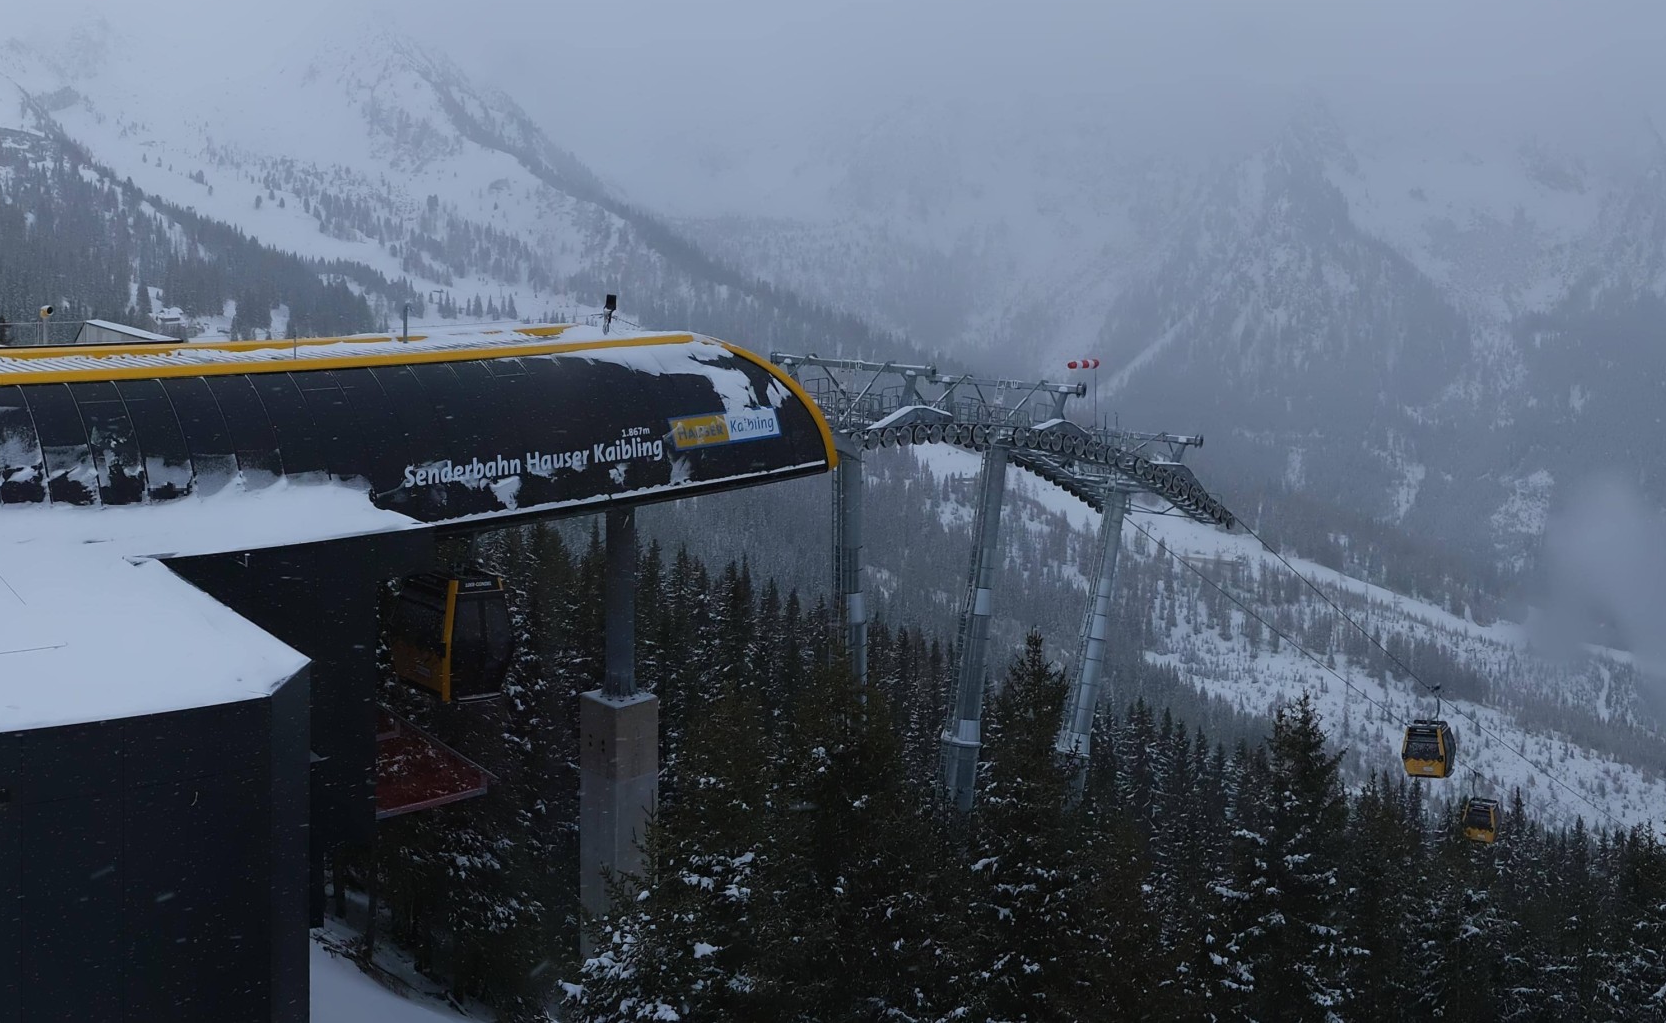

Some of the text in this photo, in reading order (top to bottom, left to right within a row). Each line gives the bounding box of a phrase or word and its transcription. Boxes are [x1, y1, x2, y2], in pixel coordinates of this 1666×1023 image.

[622, 427, 651, 437] 1.867m
[404, 437, 663, 487] Senderbahn Hauser Kaibling
